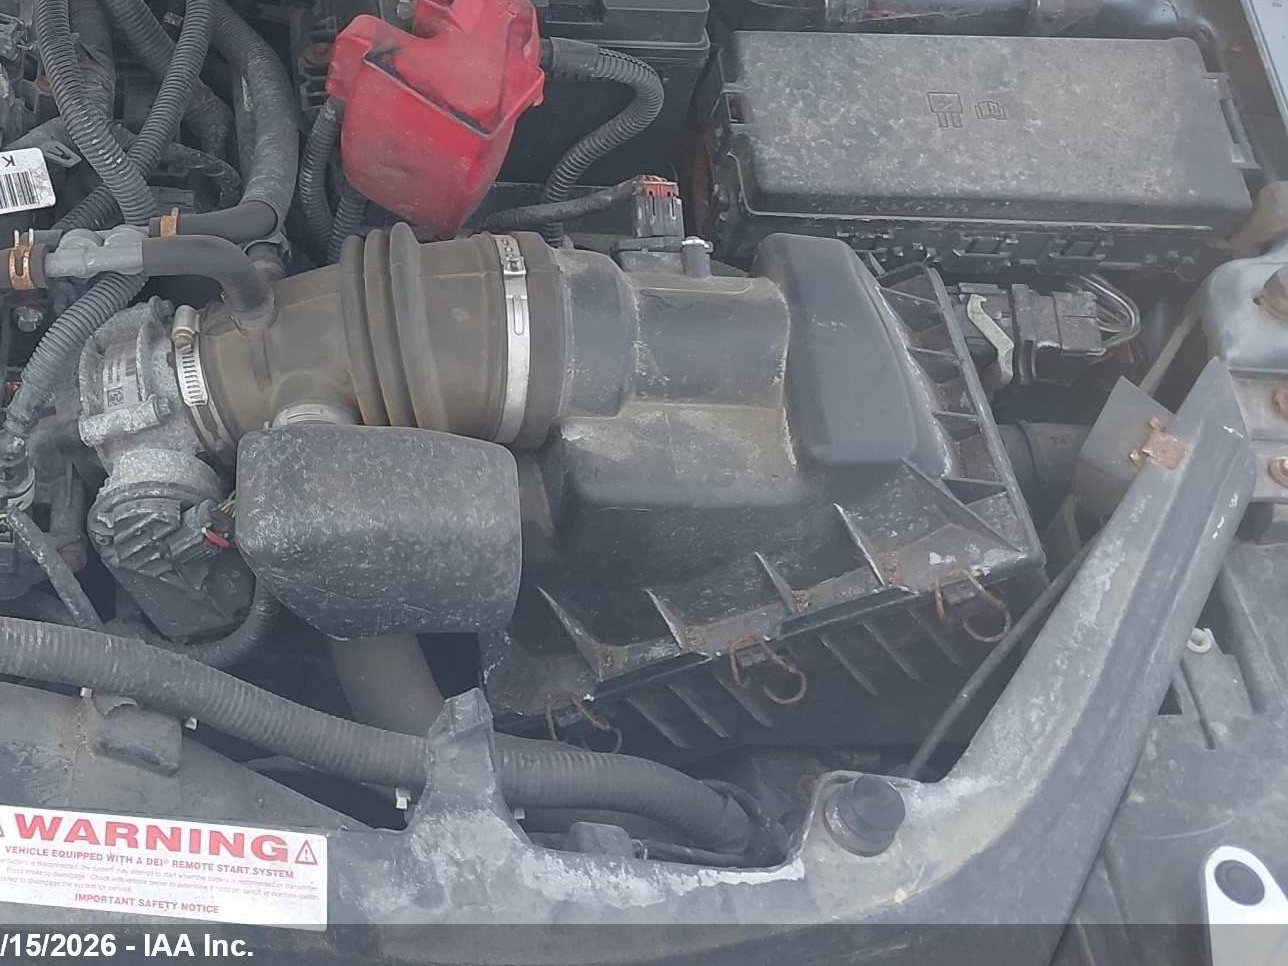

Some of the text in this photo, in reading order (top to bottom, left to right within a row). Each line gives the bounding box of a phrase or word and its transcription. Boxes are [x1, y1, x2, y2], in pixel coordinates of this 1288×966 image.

[15, 813, 289, 863] WARNING
[6, 845, 48, 857] VEHICLE
[52, 850, 103, 862] EQUIPPED
[107, 853, 132, 865] WITH
[136, 857, 143, 865] A
[172, 860, 213, 872] REMOTE
[217, 864, 249, 875] START
[253, 867, 294, 879] SYSTEM
[75, 893, 219, 914] IMPORTANT SAFETY NOTICE
